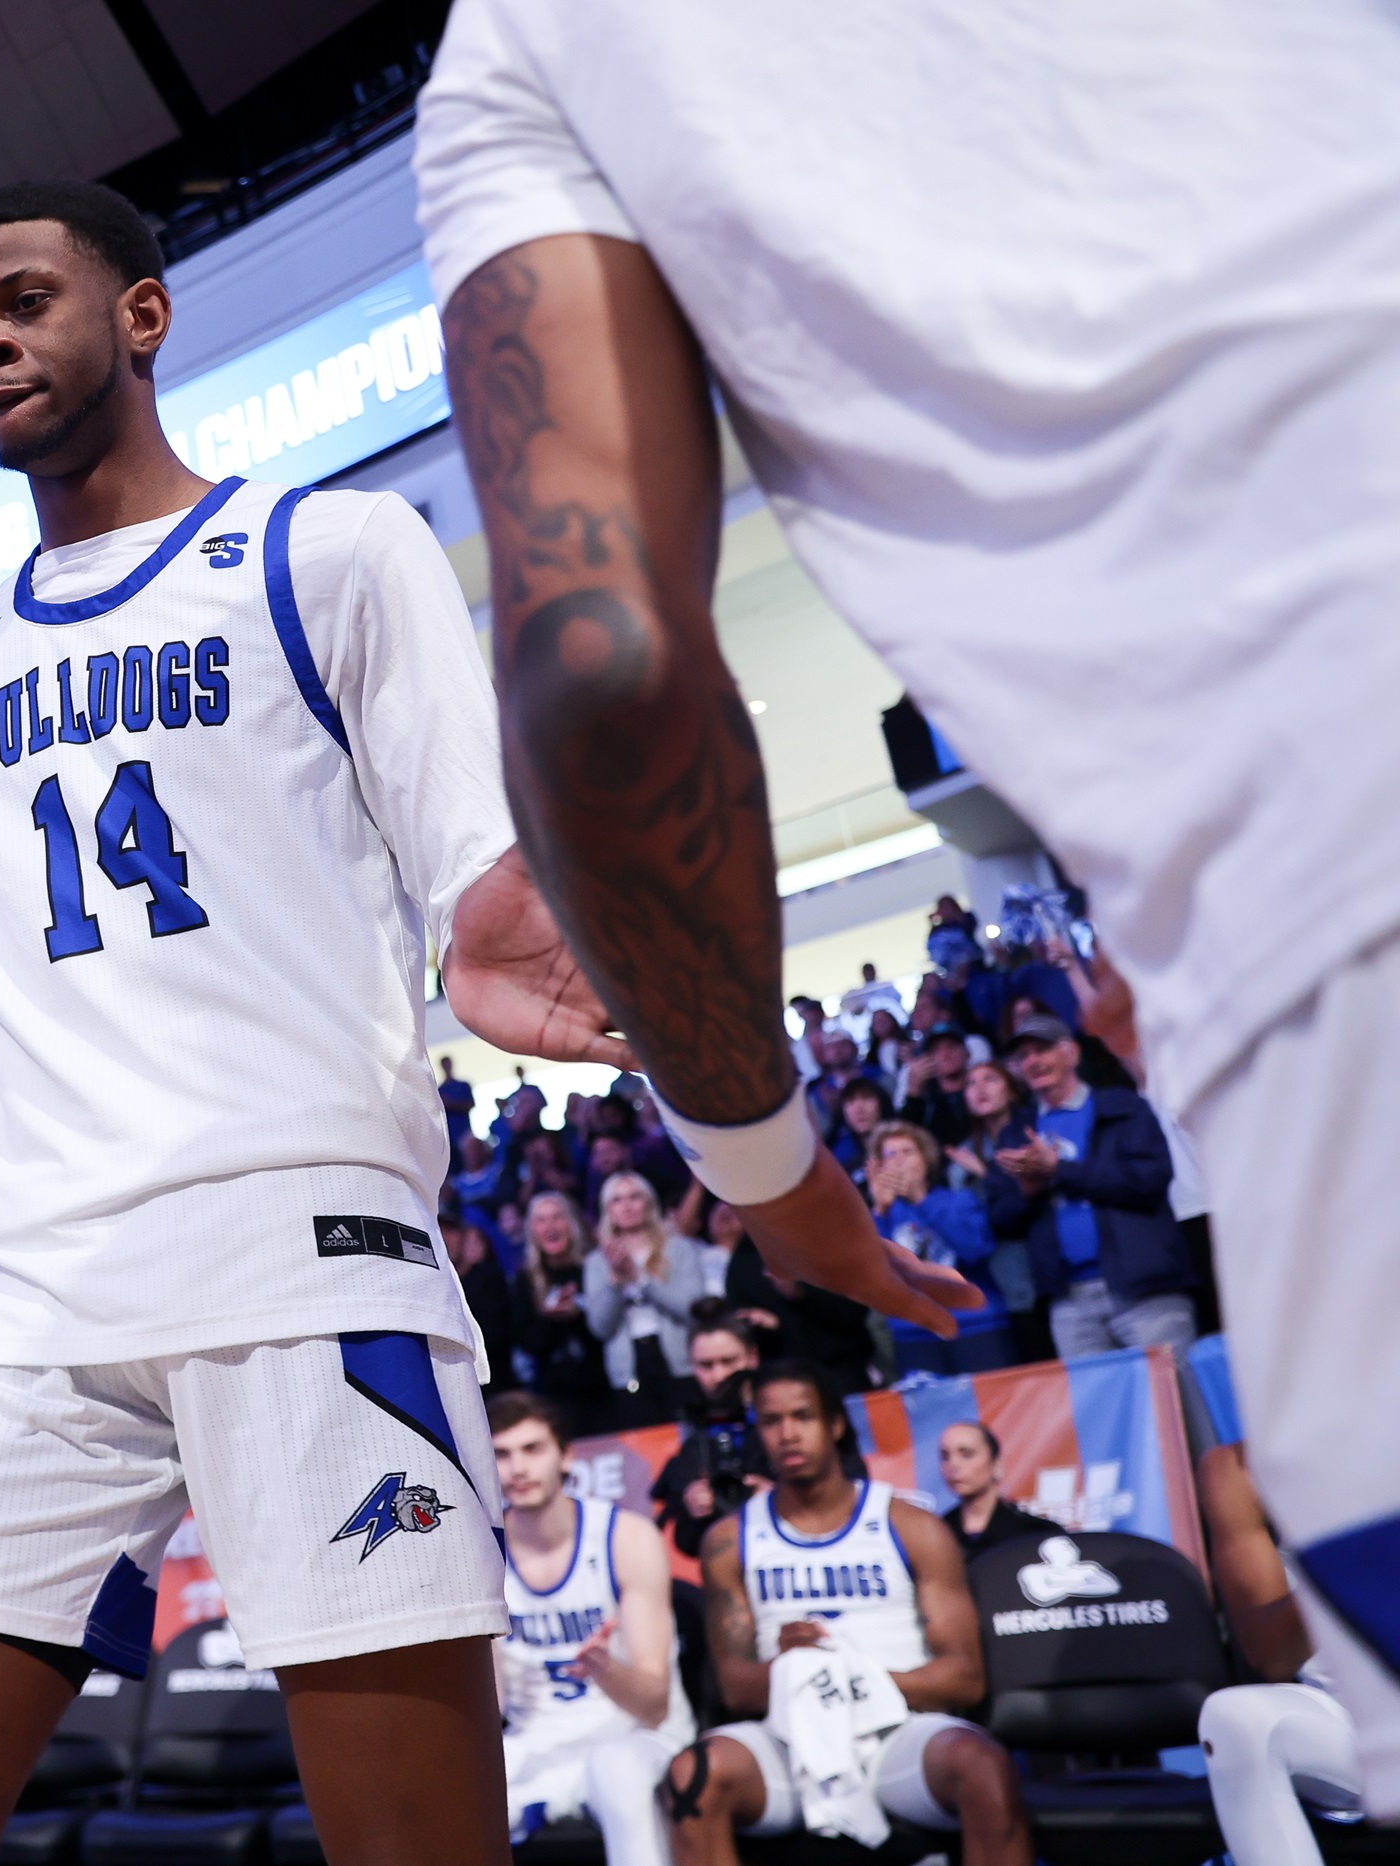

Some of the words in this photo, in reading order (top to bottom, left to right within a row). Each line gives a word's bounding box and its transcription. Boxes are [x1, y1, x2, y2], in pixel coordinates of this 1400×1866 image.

[200, 541, 227, 552] BIG
[31, 760, 210, 963] 14
[322, 1237, 360, 1247] adidas
[381, 1235, 389, 1248] L
[755, 1563, 888, 1602] BULLDOGS
[993, 1606, 1104, 1636] HERCULES
[1105, 1599, 1170, 1624] TIRES
